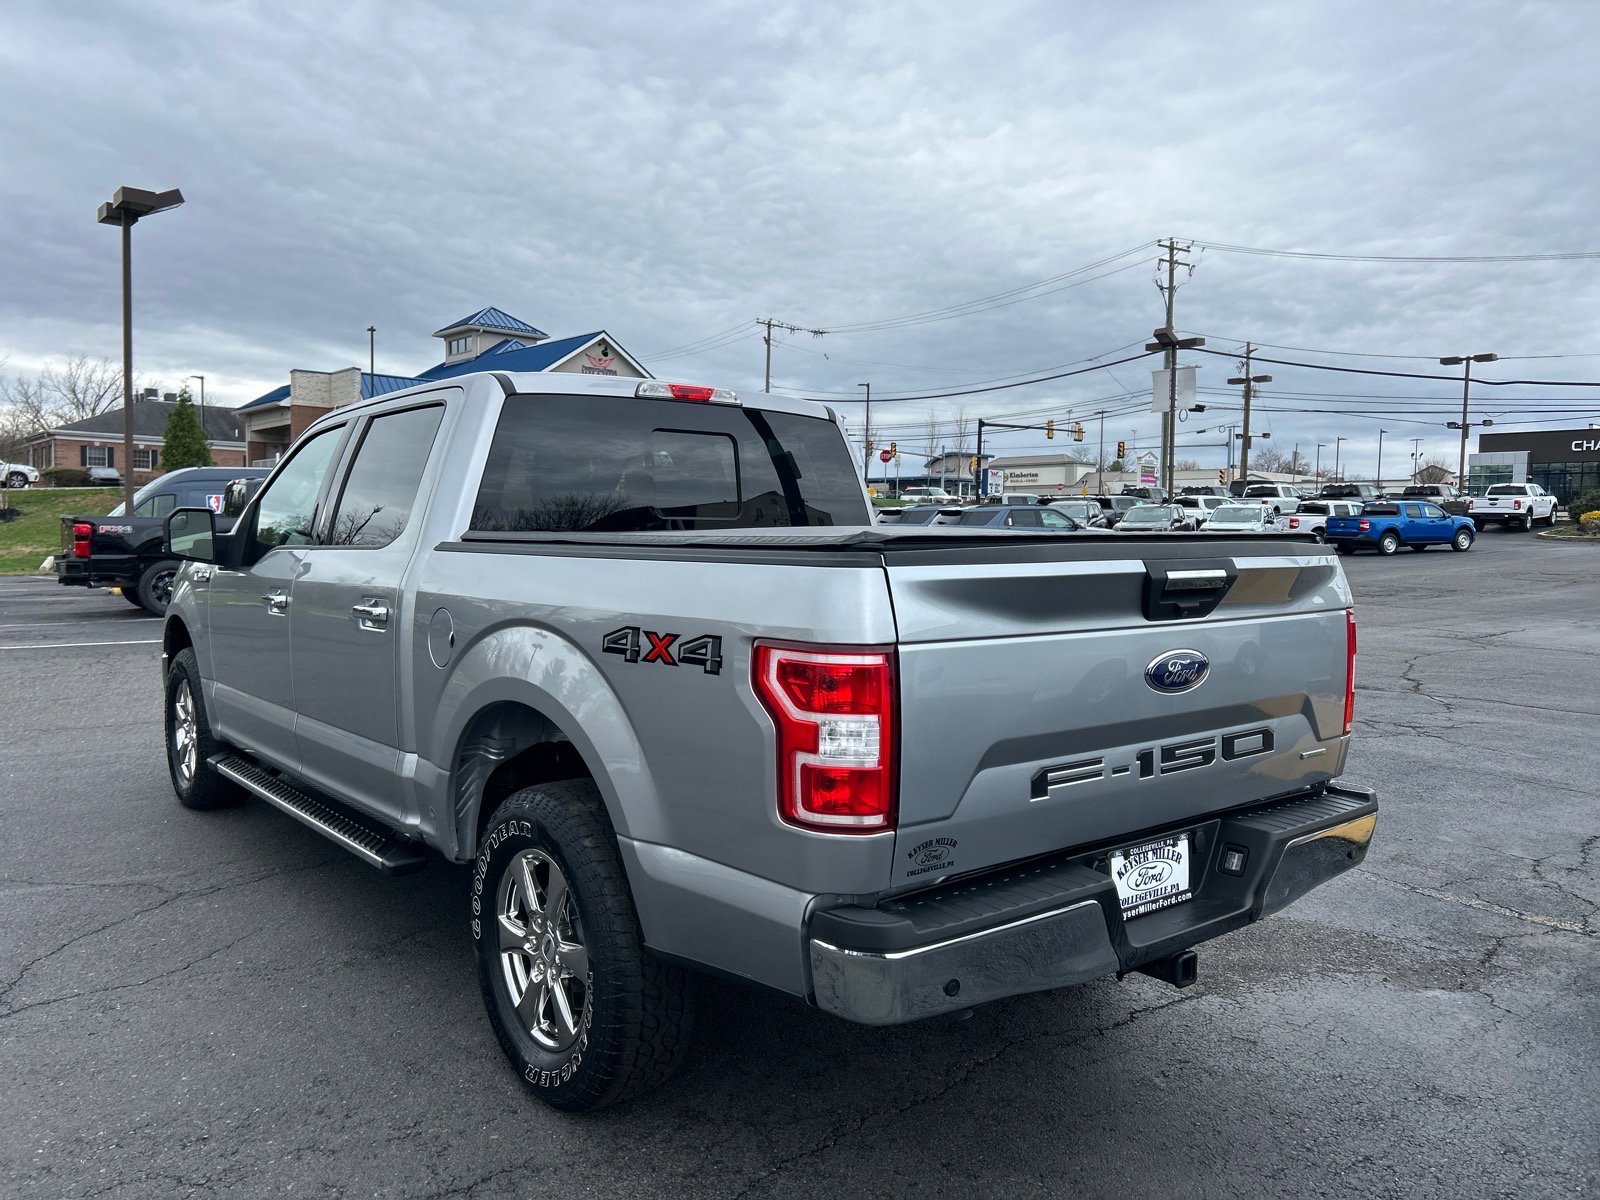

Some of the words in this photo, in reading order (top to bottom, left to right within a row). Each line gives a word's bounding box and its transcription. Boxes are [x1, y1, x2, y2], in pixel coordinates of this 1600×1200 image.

[602, 625, 723, 676] 4X4
[1030, 726, 1275, 802] F-150
[907, 840, 934, 859] KEYSER
[935, 837, 958, 848] MILLER
[921, 849, 944, 863] Ford
[1116, 851, 1149, 880] KEYSER
[1151, 848, 1182, 864] MILLER
[472, 820, 532, 940] GOODYEAR
[1135, 865, 1164, 888] Ford
